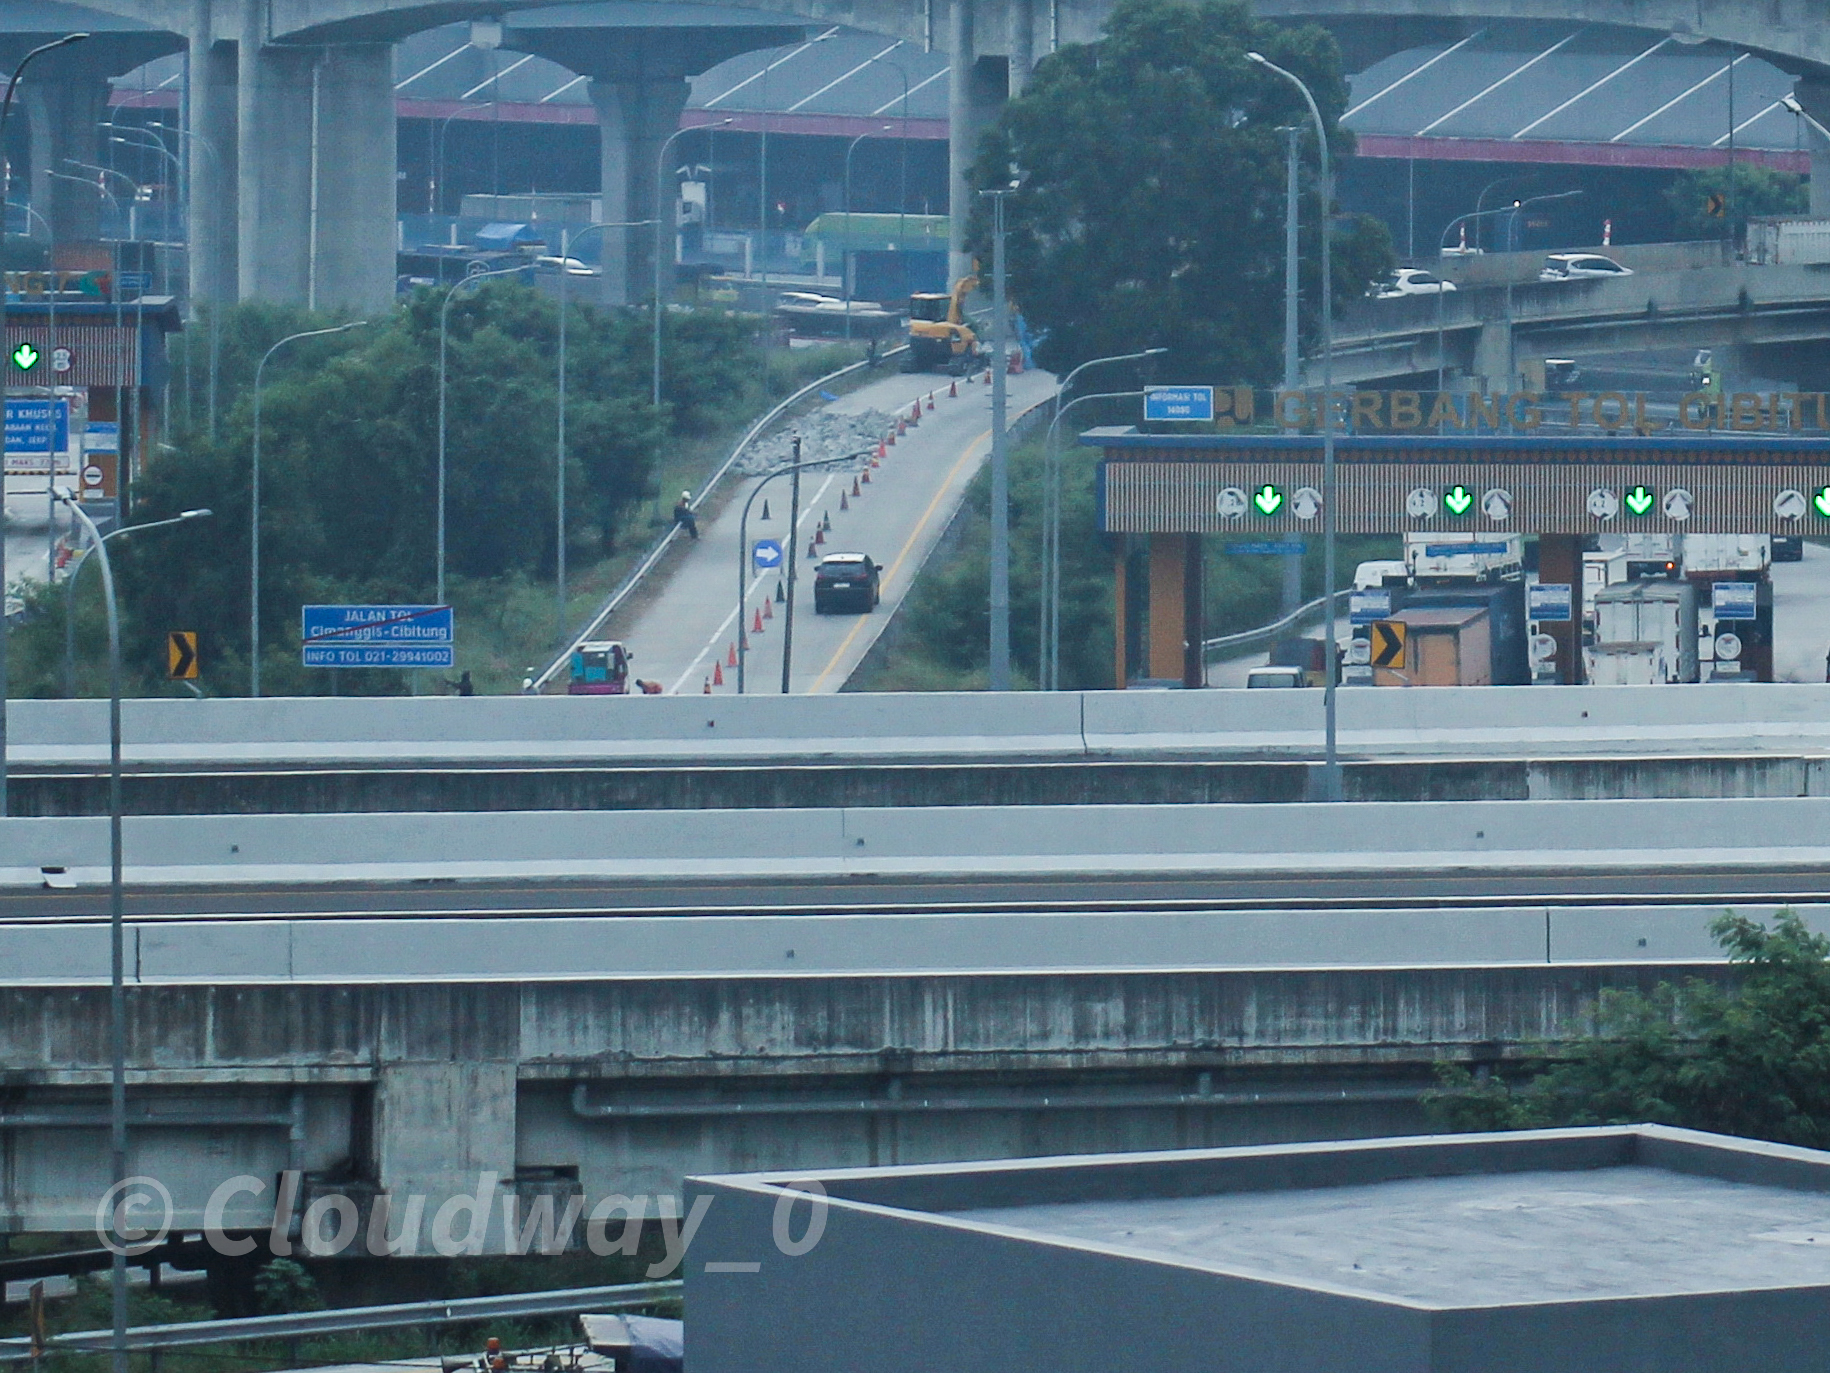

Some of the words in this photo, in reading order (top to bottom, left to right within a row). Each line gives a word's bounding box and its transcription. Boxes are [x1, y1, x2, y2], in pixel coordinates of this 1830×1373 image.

[1275, 390, 1541, 428] GERBANG
[1561, 391, 1660, 431] TOL
[344, 610, 386, 622] JALAN
[390, 610, 414, 622] TOL
[306, 651, 335, 662] INFO
[340, 651, 361, 662] TOL
